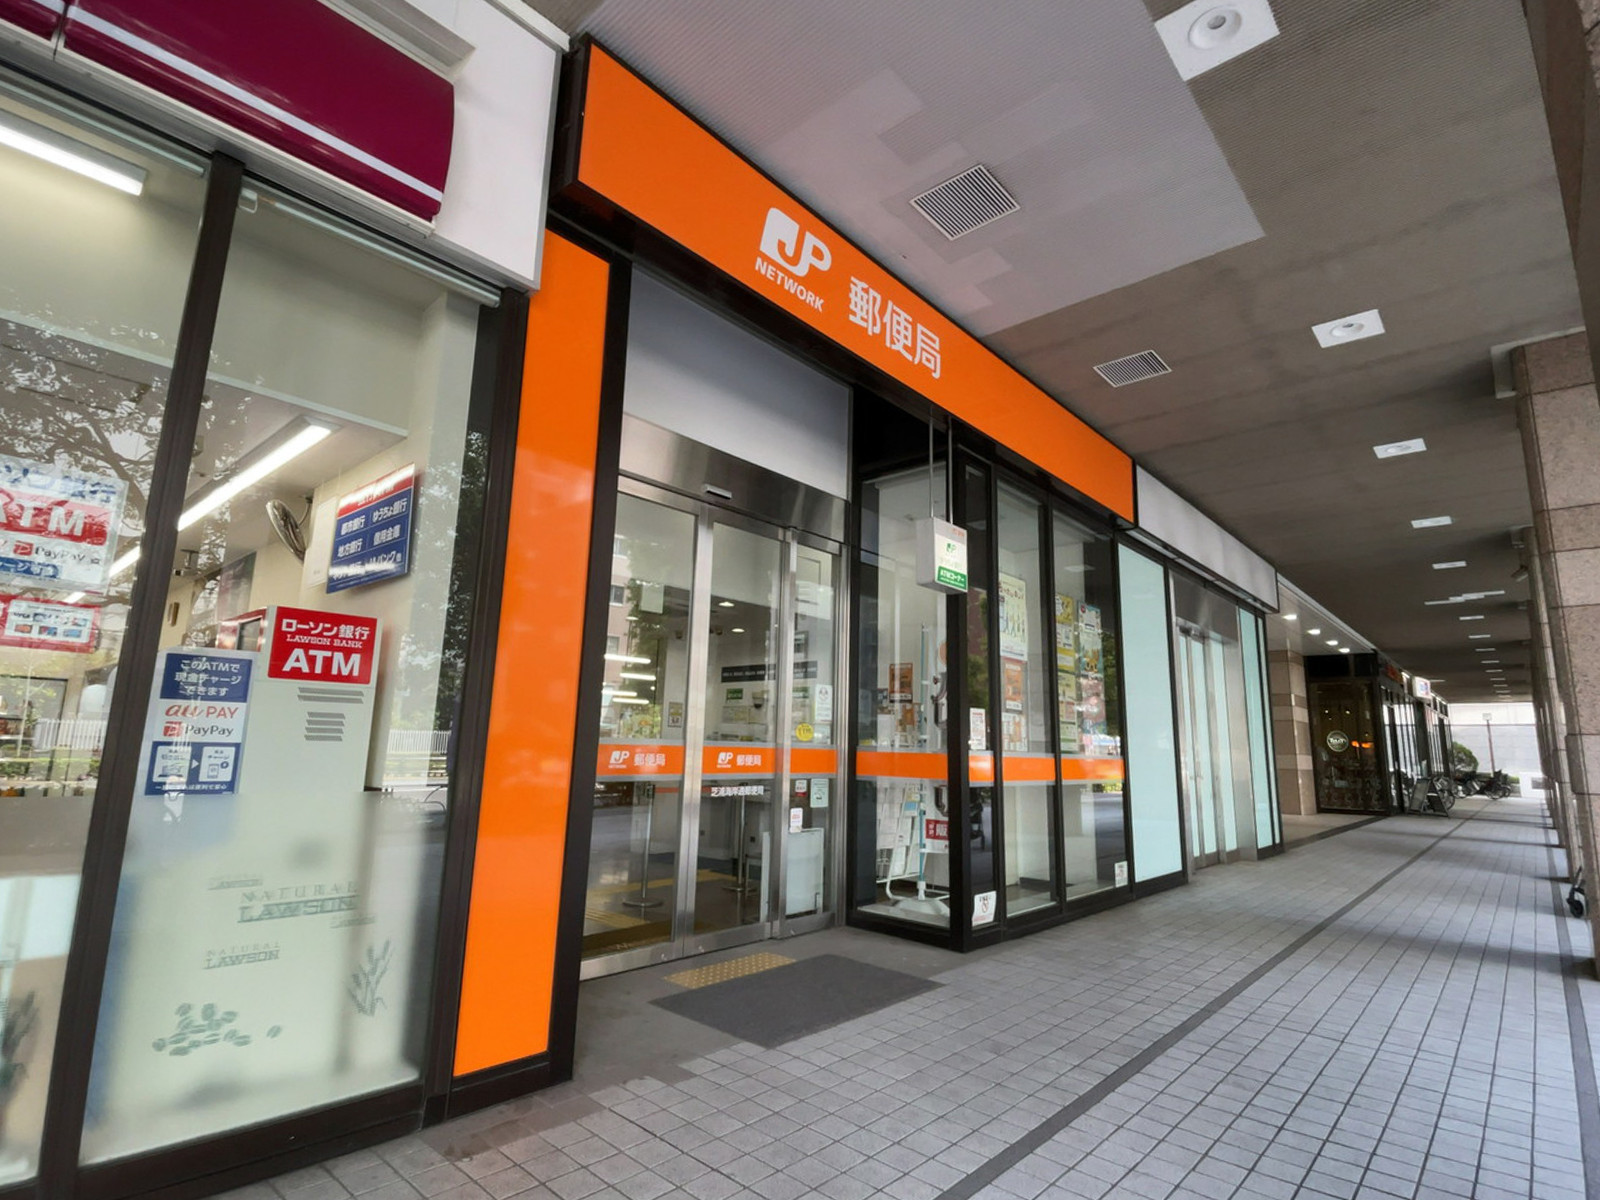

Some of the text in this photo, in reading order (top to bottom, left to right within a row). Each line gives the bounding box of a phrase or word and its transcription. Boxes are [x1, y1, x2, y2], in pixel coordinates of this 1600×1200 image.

[759, 207, 832, 277] JP
[755, 257, 825, 312] NETWORK
[849, 276, 942, 379] 郵便局
[372, 498, 408, 523] ゆうちょ銀行
[281, 618, 370, 640] ローソン銀行
[286, 634, 363, 648] LAWSON BANK
[181, 659, 240, 673] このATMで
[282, 648, 361, 676] ATM
[174, 671, 242, 685] 現金チャージ
[186, 686, 229, 696] できます
[206, 705, 239, 719] PAY
[185, 723, 234, 738] PayPay
[634, 753, 666, 766] 郵便局
[736, 754, 762, 766] 郵便局
[240, 880, 358, 902] NATURAL
[237, 894, 360, 924] LAWSON
[202, 949, 280, 970] LAWSON
